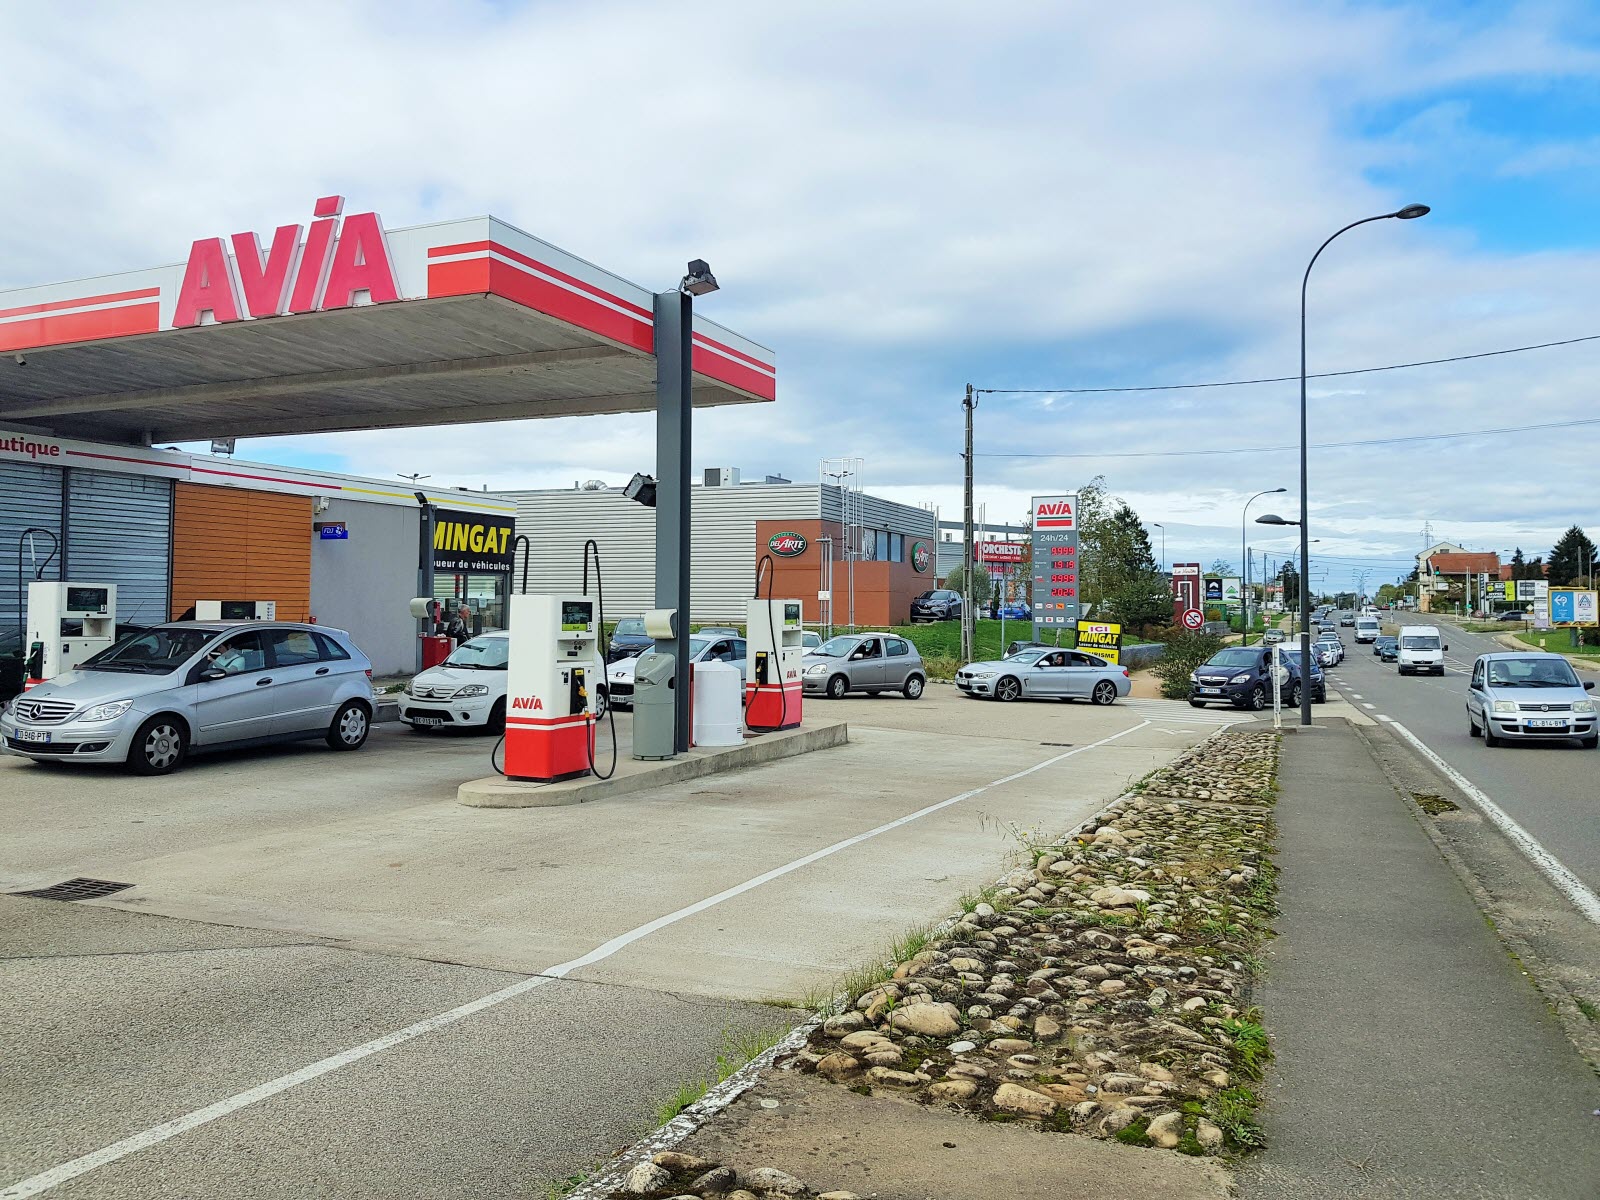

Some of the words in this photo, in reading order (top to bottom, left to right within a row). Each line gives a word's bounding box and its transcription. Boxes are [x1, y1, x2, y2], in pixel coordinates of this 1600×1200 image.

[1040, 534, 1069, 542] 24h/24
[774, 539, 804, 551] ARTE
[434, 560, 455, 568] ueur
[459, 560, 469, 569] de
[472, 561, 510, 571] véhicules
[1079, 631, 1118, 645] MINGAT
[512, 695, 543, 710] AVIA
